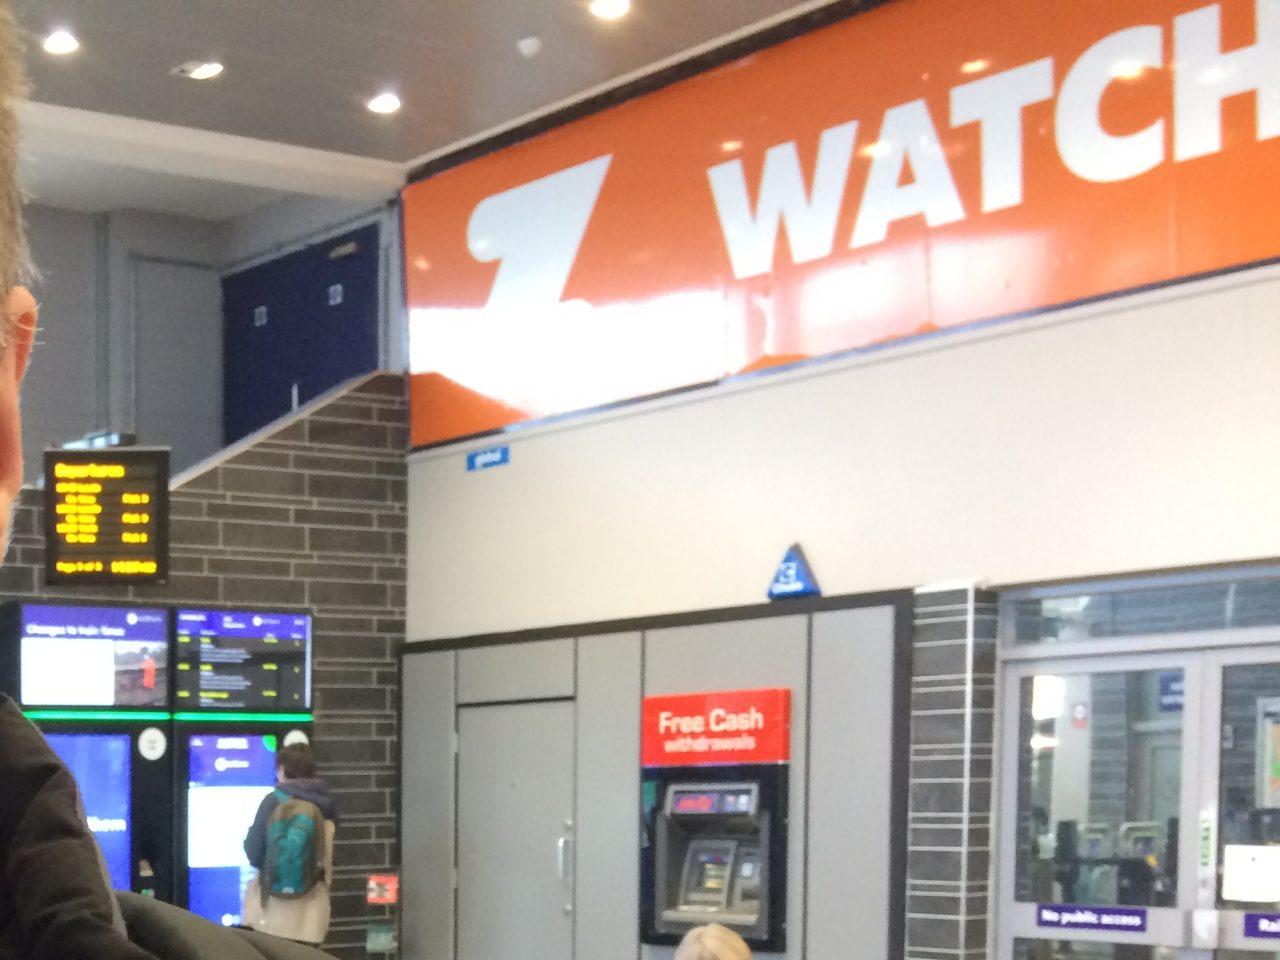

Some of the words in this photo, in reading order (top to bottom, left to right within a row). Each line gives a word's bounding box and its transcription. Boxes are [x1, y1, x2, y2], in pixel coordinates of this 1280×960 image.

[706, 0, 1280, 280] WATCH
[658, 711, 705, 734] Free
[709, 707, 764, 732] Cash
[1041, 908, 1060, 922] No
[1060, 910, 1098, 926] public
[1100, 914, 1142, 926] access
